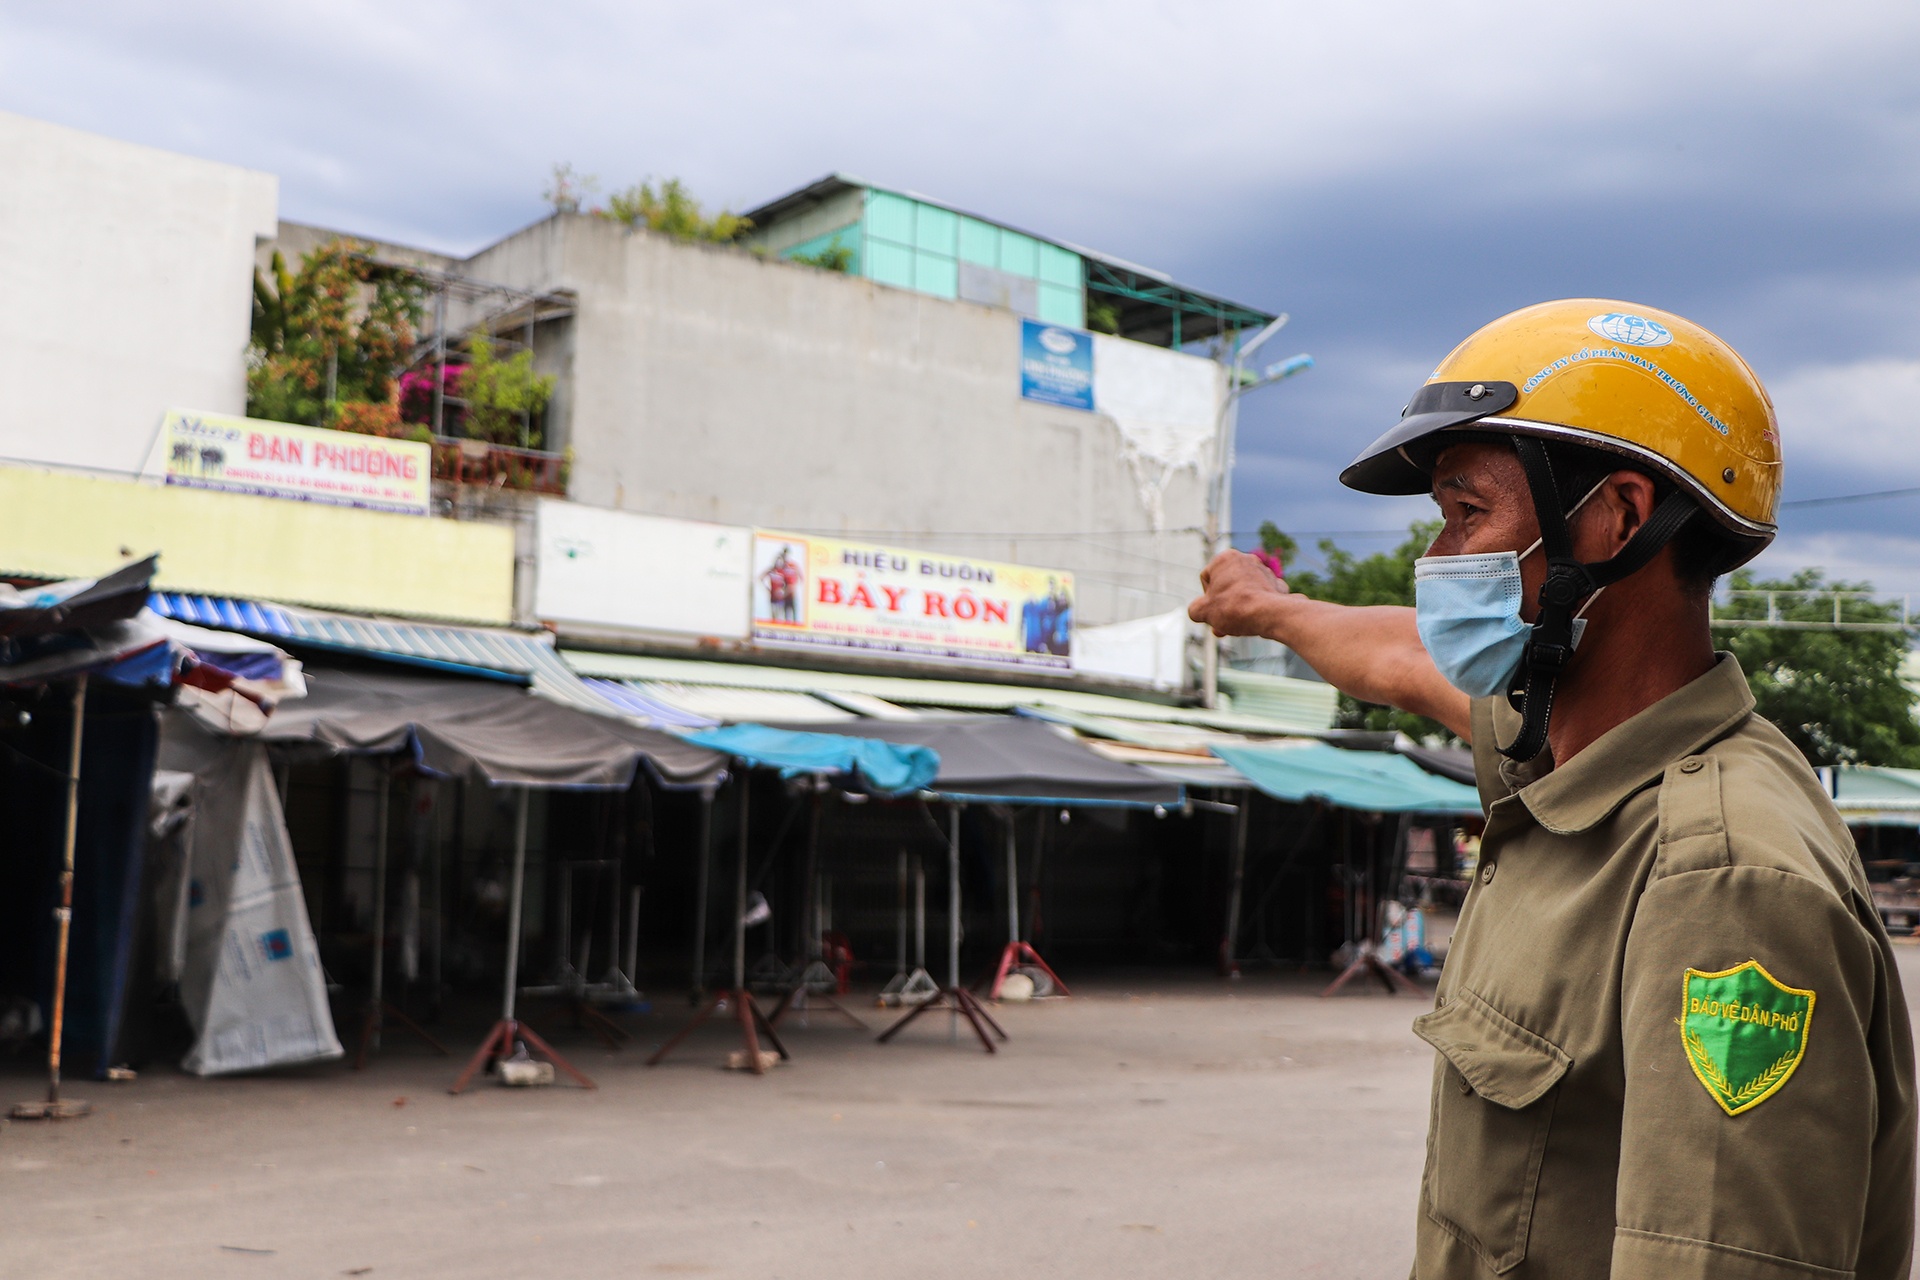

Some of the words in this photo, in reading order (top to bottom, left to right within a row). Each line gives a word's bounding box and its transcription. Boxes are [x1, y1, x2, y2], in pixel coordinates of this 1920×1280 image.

[1522, 366, 1553, 393] CÔNG
[1551, 356, 1568, 371] TY
[1590, 346, 1627, 360] PHẦN
[1627, 354, 1657, 372] MAY
[1656, 368, 1698, 407] TRƯỜNG
[1696, 404, 1729, 435] GIANG
[842, 549, 908, 573] HIỆU
[919, 557, 994, 584] BUÔN
[1690, 994, 1720, 1016] BẢO
[1721, 999, 1740, 1024] VỆ
[1740, 1003, 1770, 1027] DÂN
[1769, 1010, 1803, 1032] PHỐ
